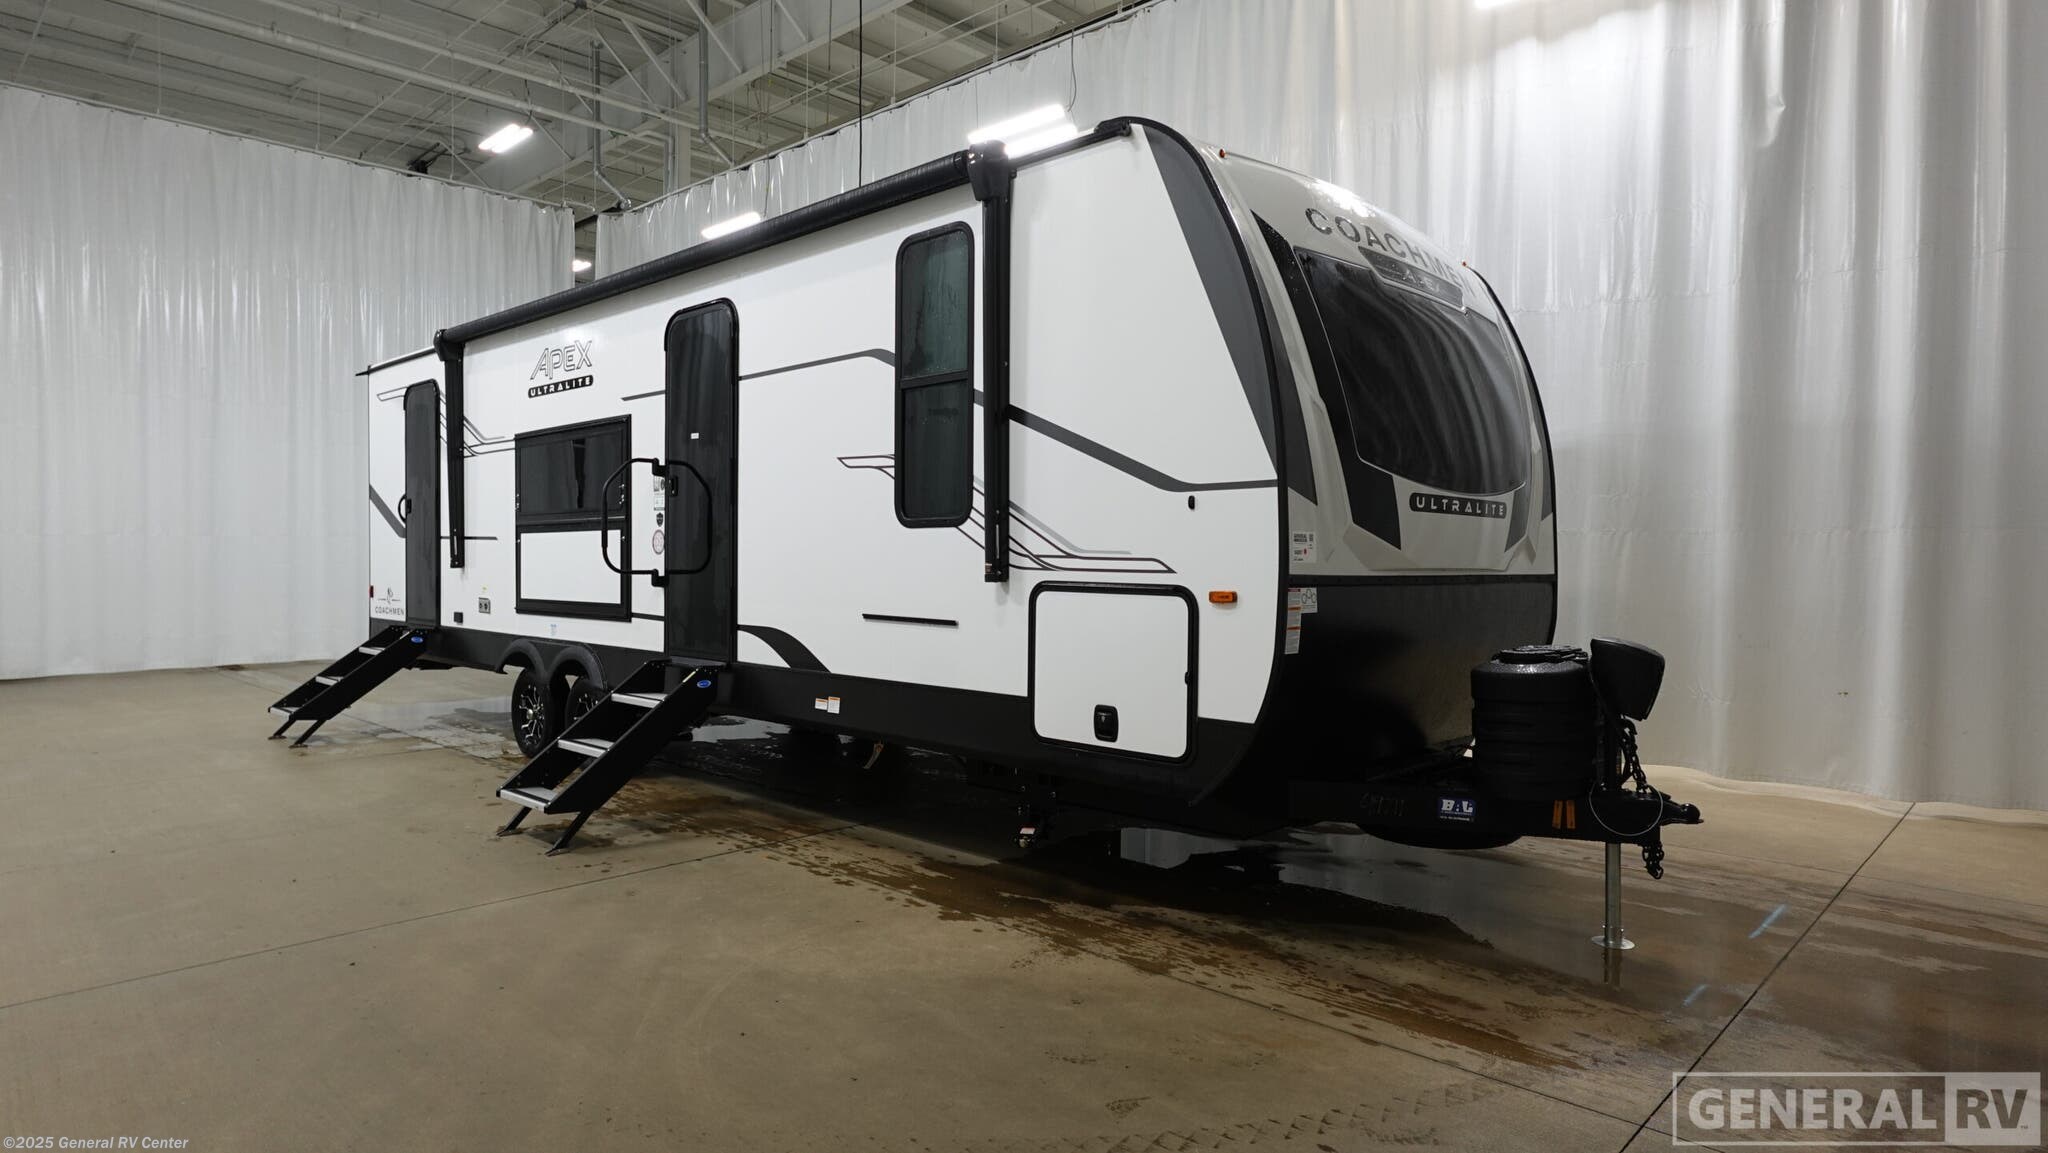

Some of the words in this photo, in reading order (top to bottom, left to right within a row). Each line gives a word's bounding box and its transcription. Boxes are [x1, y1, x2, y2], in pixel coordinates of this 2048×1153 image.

[529, 340, 592, 380] APEX
[530, 376, 590, 396] ULTRALITE
[1416, 496, 1504, 516] ULTRALITE
[375, 606, 404, 615] COACHMEN
